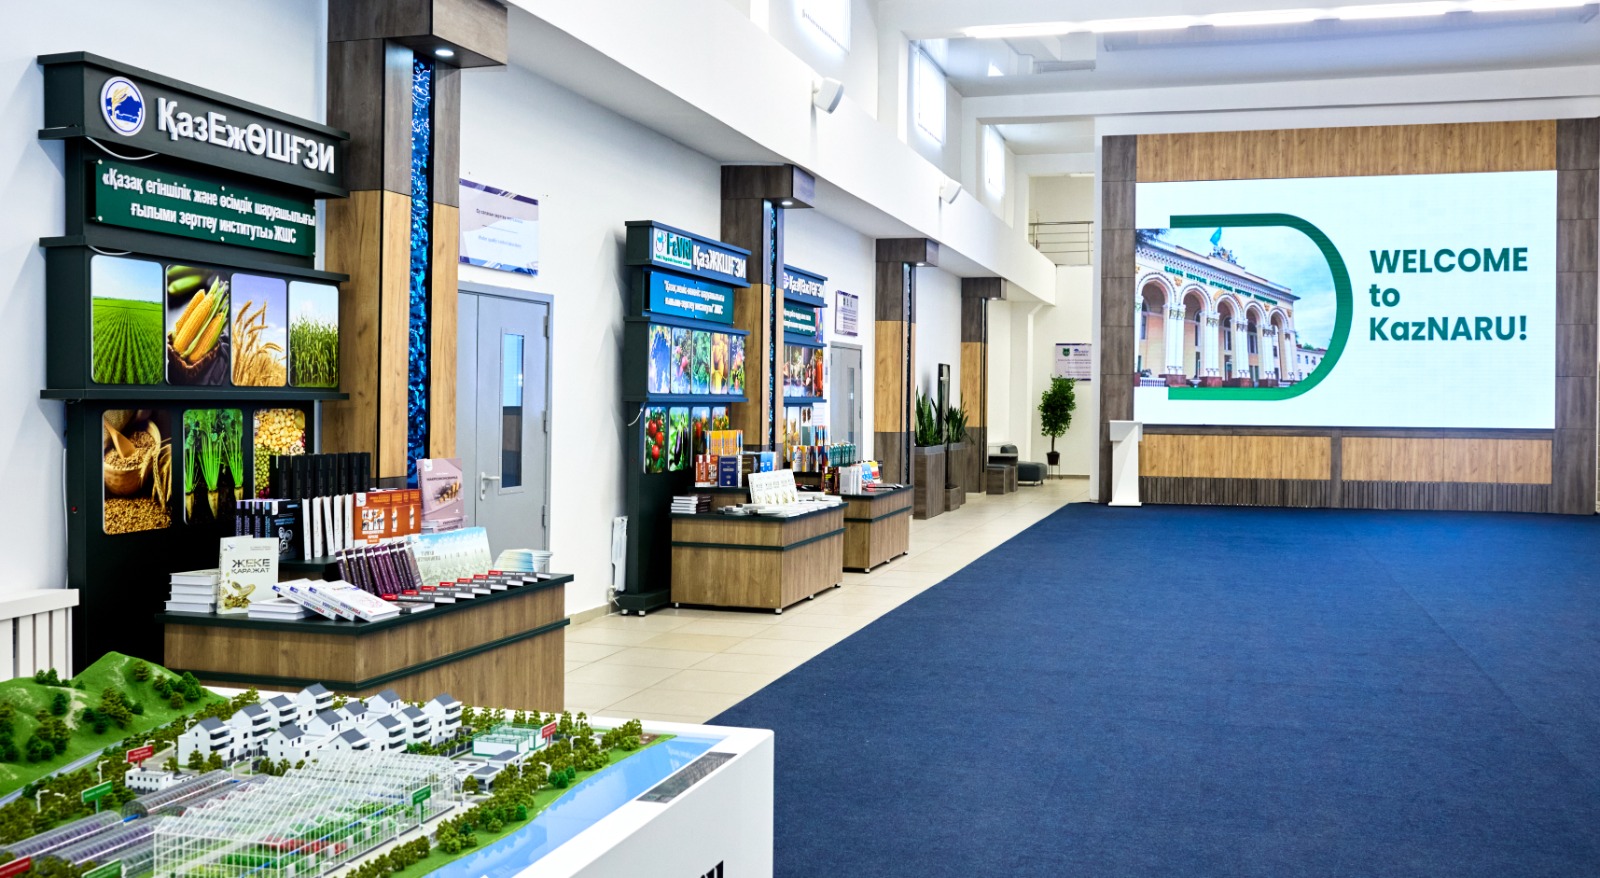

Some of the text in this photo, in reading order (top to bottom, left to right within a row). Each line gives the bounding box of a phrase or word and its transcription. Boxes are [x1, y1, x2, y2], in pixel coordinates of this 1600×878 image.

[157, 97, 336, 174] ҚазЕжӨШҒЗИ
[145, 178, 193, 201] егіншілік
[193, 188, 218, 206] және
[219, 192, 253, 215] өсімдік
[130, 202, 177, 223] ғылыми
[178, 211, 218, 234] зерттеу
[273, 225, 296, 244] ЖШС
[1369, 247, 1528, 274] WELCOME
[1369, 282, 1401, 307] to
[1369, 315, 1528, 342] KazNARU!
[232, 559, 270, 568] ЖЕКЕ
